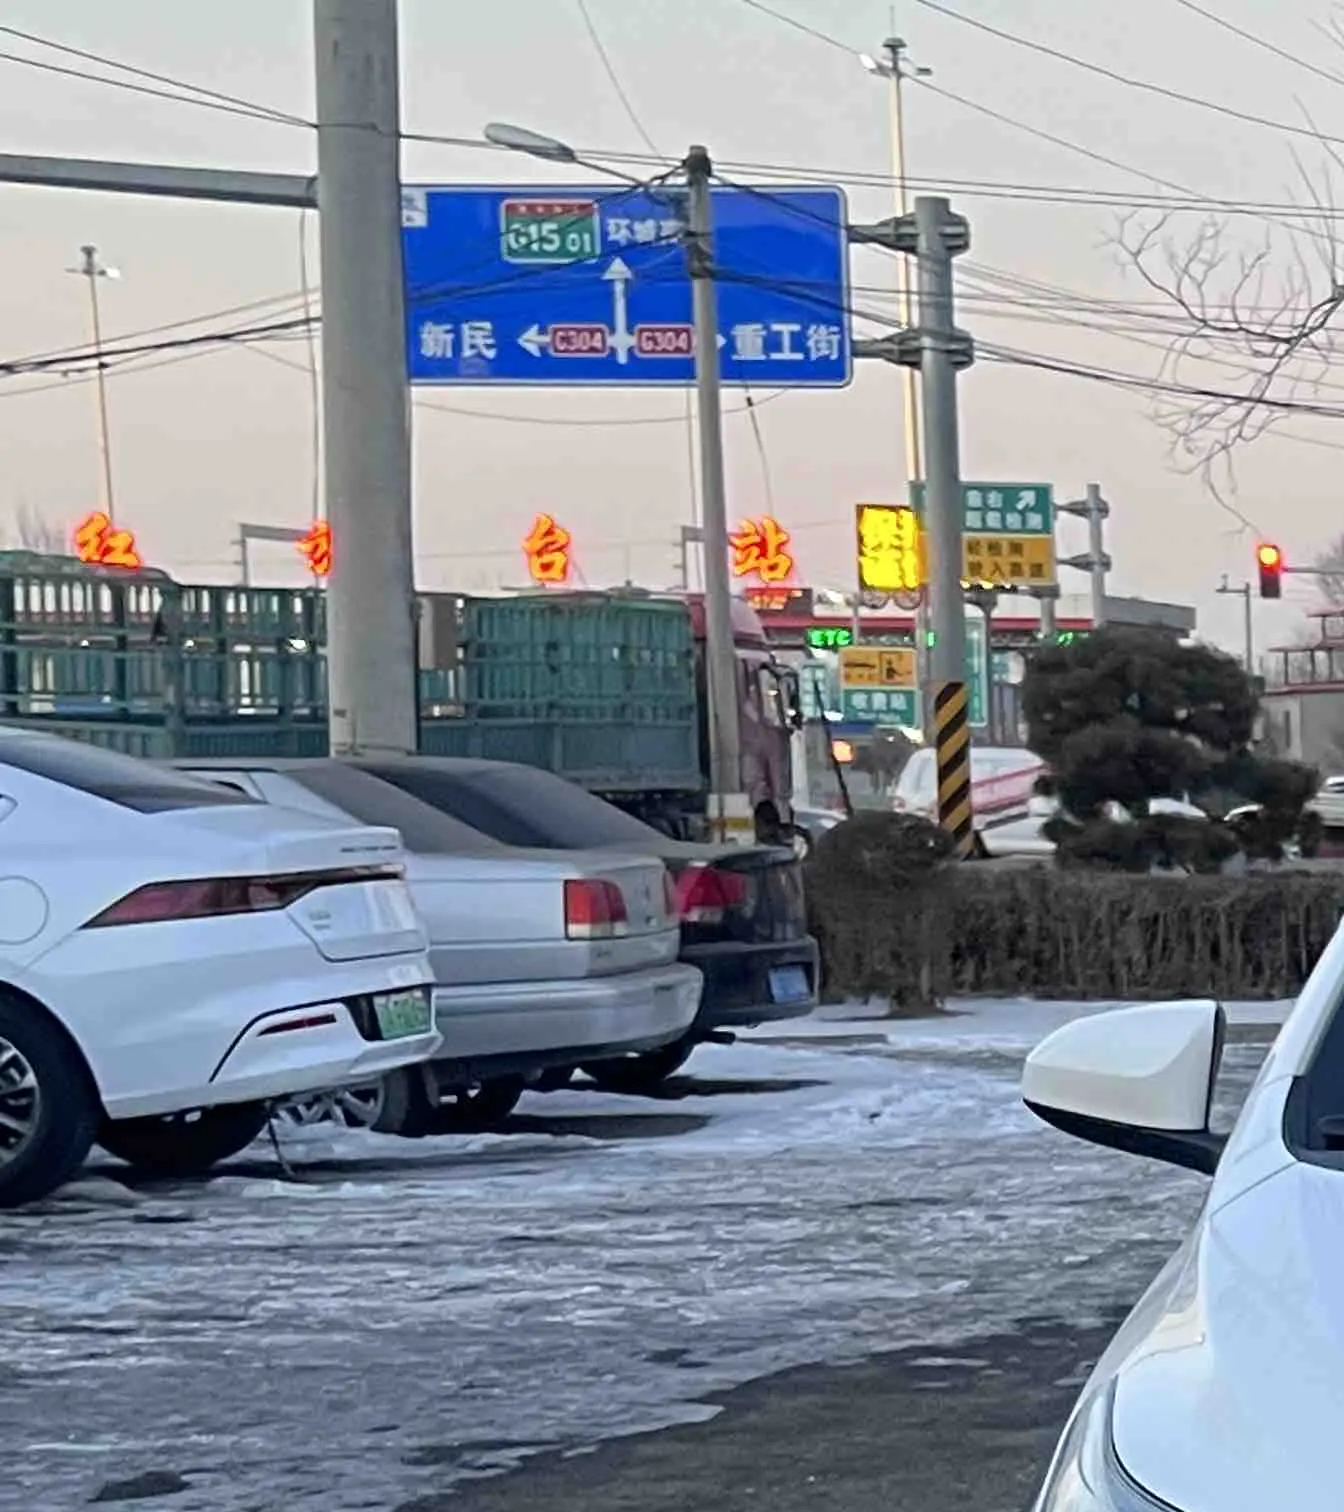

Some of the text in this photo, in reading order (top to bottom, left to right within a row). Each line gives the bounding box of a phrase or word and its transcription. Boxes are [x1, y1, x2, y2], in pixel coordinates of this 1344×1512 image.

[420, 321, 498, 360] 新民
[554, 331, 604, 352] G304
[638, 332, 689, 352] G304
[730, 322, 841, 362] 重工街
[808, 629, 851, 648] ETC
